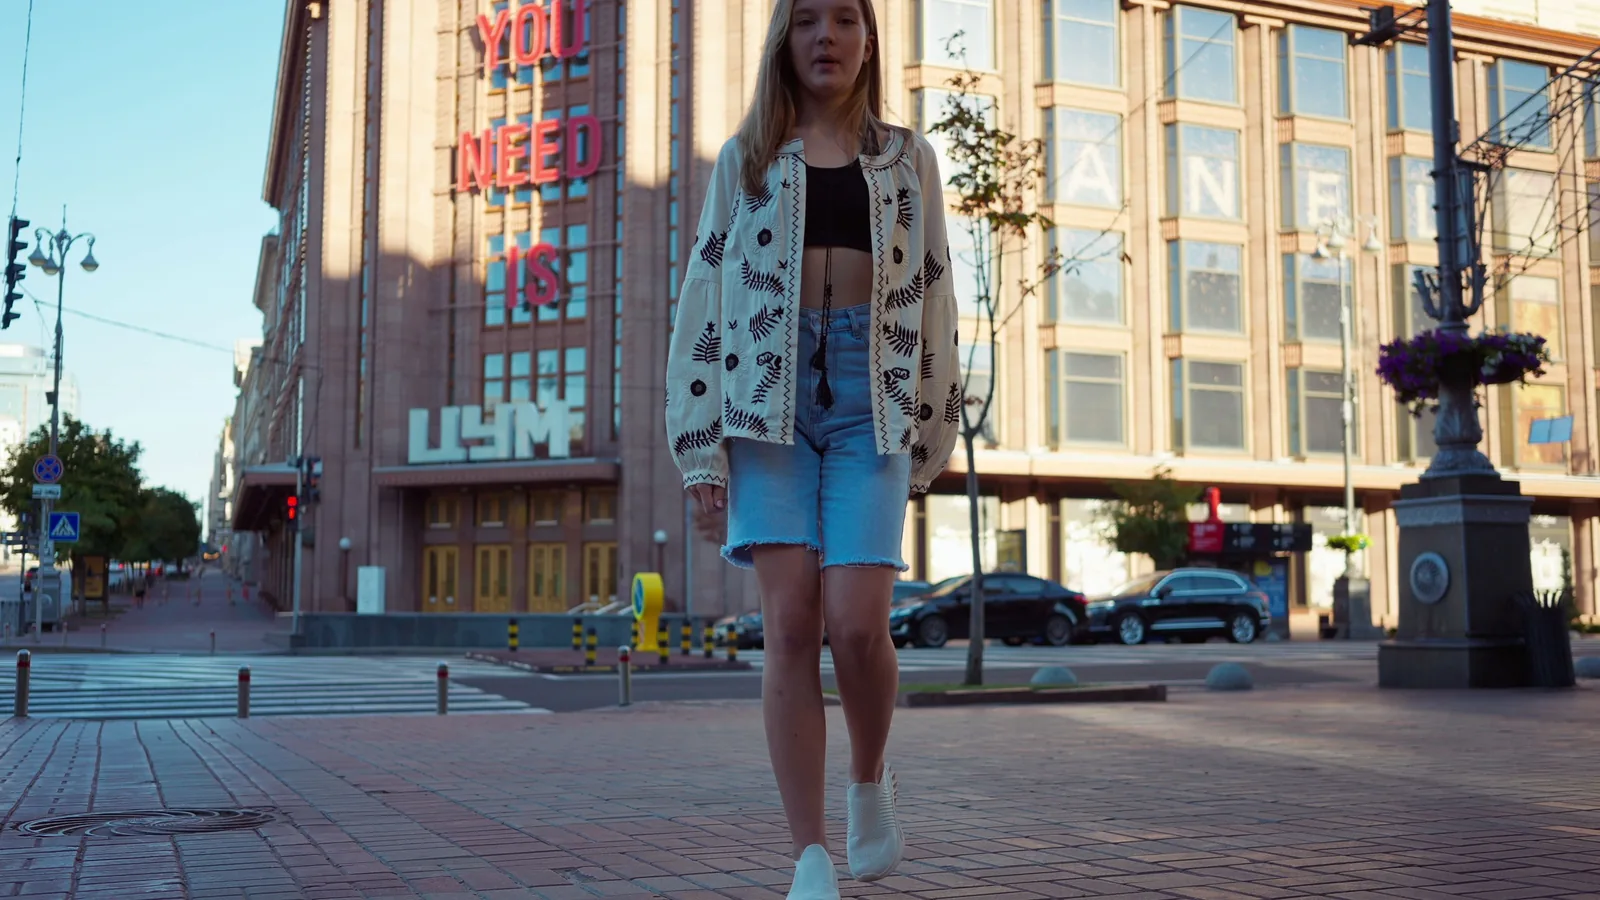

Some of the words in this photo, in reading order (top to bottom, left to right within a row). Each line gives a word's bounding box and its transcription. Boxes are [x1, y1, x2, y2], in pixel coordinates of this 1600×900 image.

[476, 0, 585, 70] YOU
[457, 114, 603, 192] NEED
[507, 242, 558, 308] IS
[408, 401, 570, 464] ЦУМ
